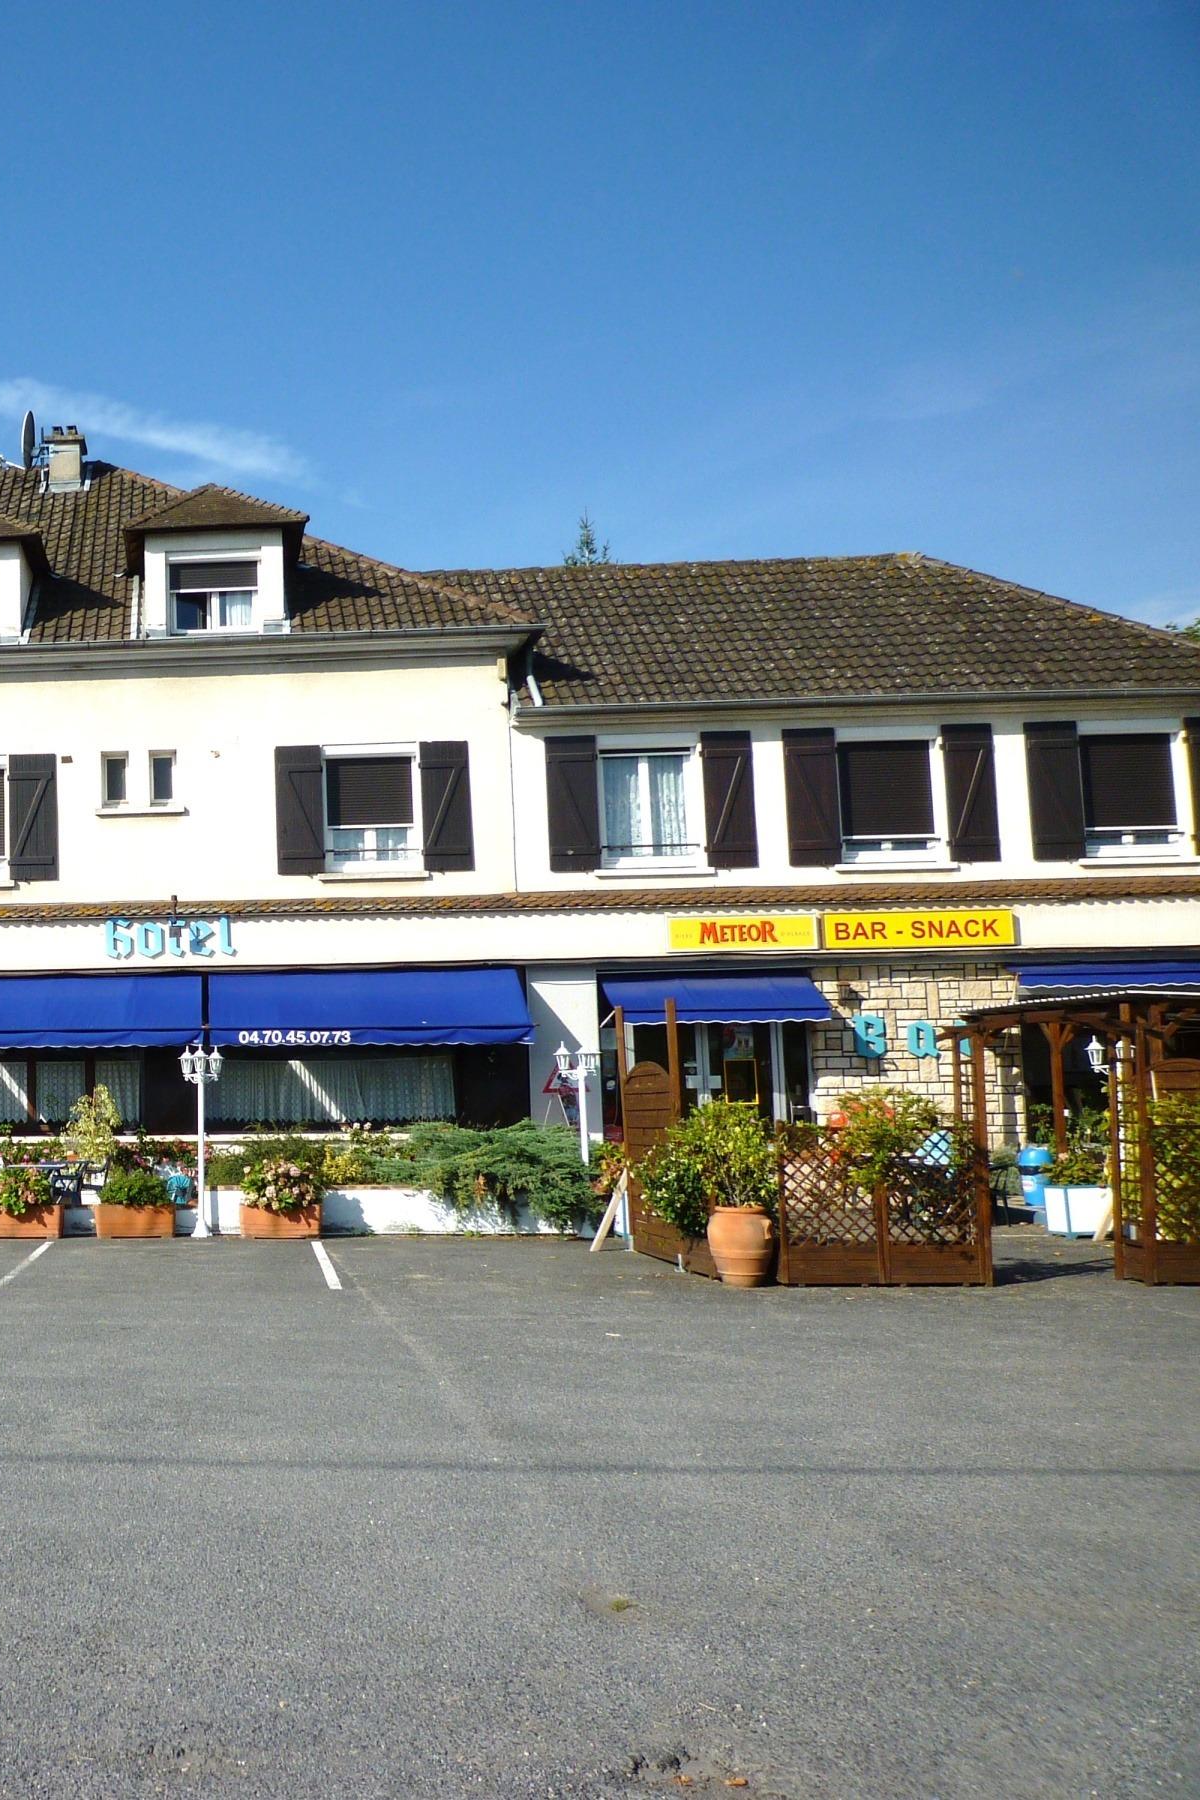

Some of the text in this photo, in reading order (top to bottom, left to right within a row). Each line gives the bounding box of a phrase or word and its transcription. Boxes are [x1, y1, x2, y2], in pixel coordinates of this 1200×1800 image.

[834, 922, 887, 940] BAR
[911, 919, 1000, 938] SNACK
[238, 1031, 351, 1044] 04.70.45.07.73
